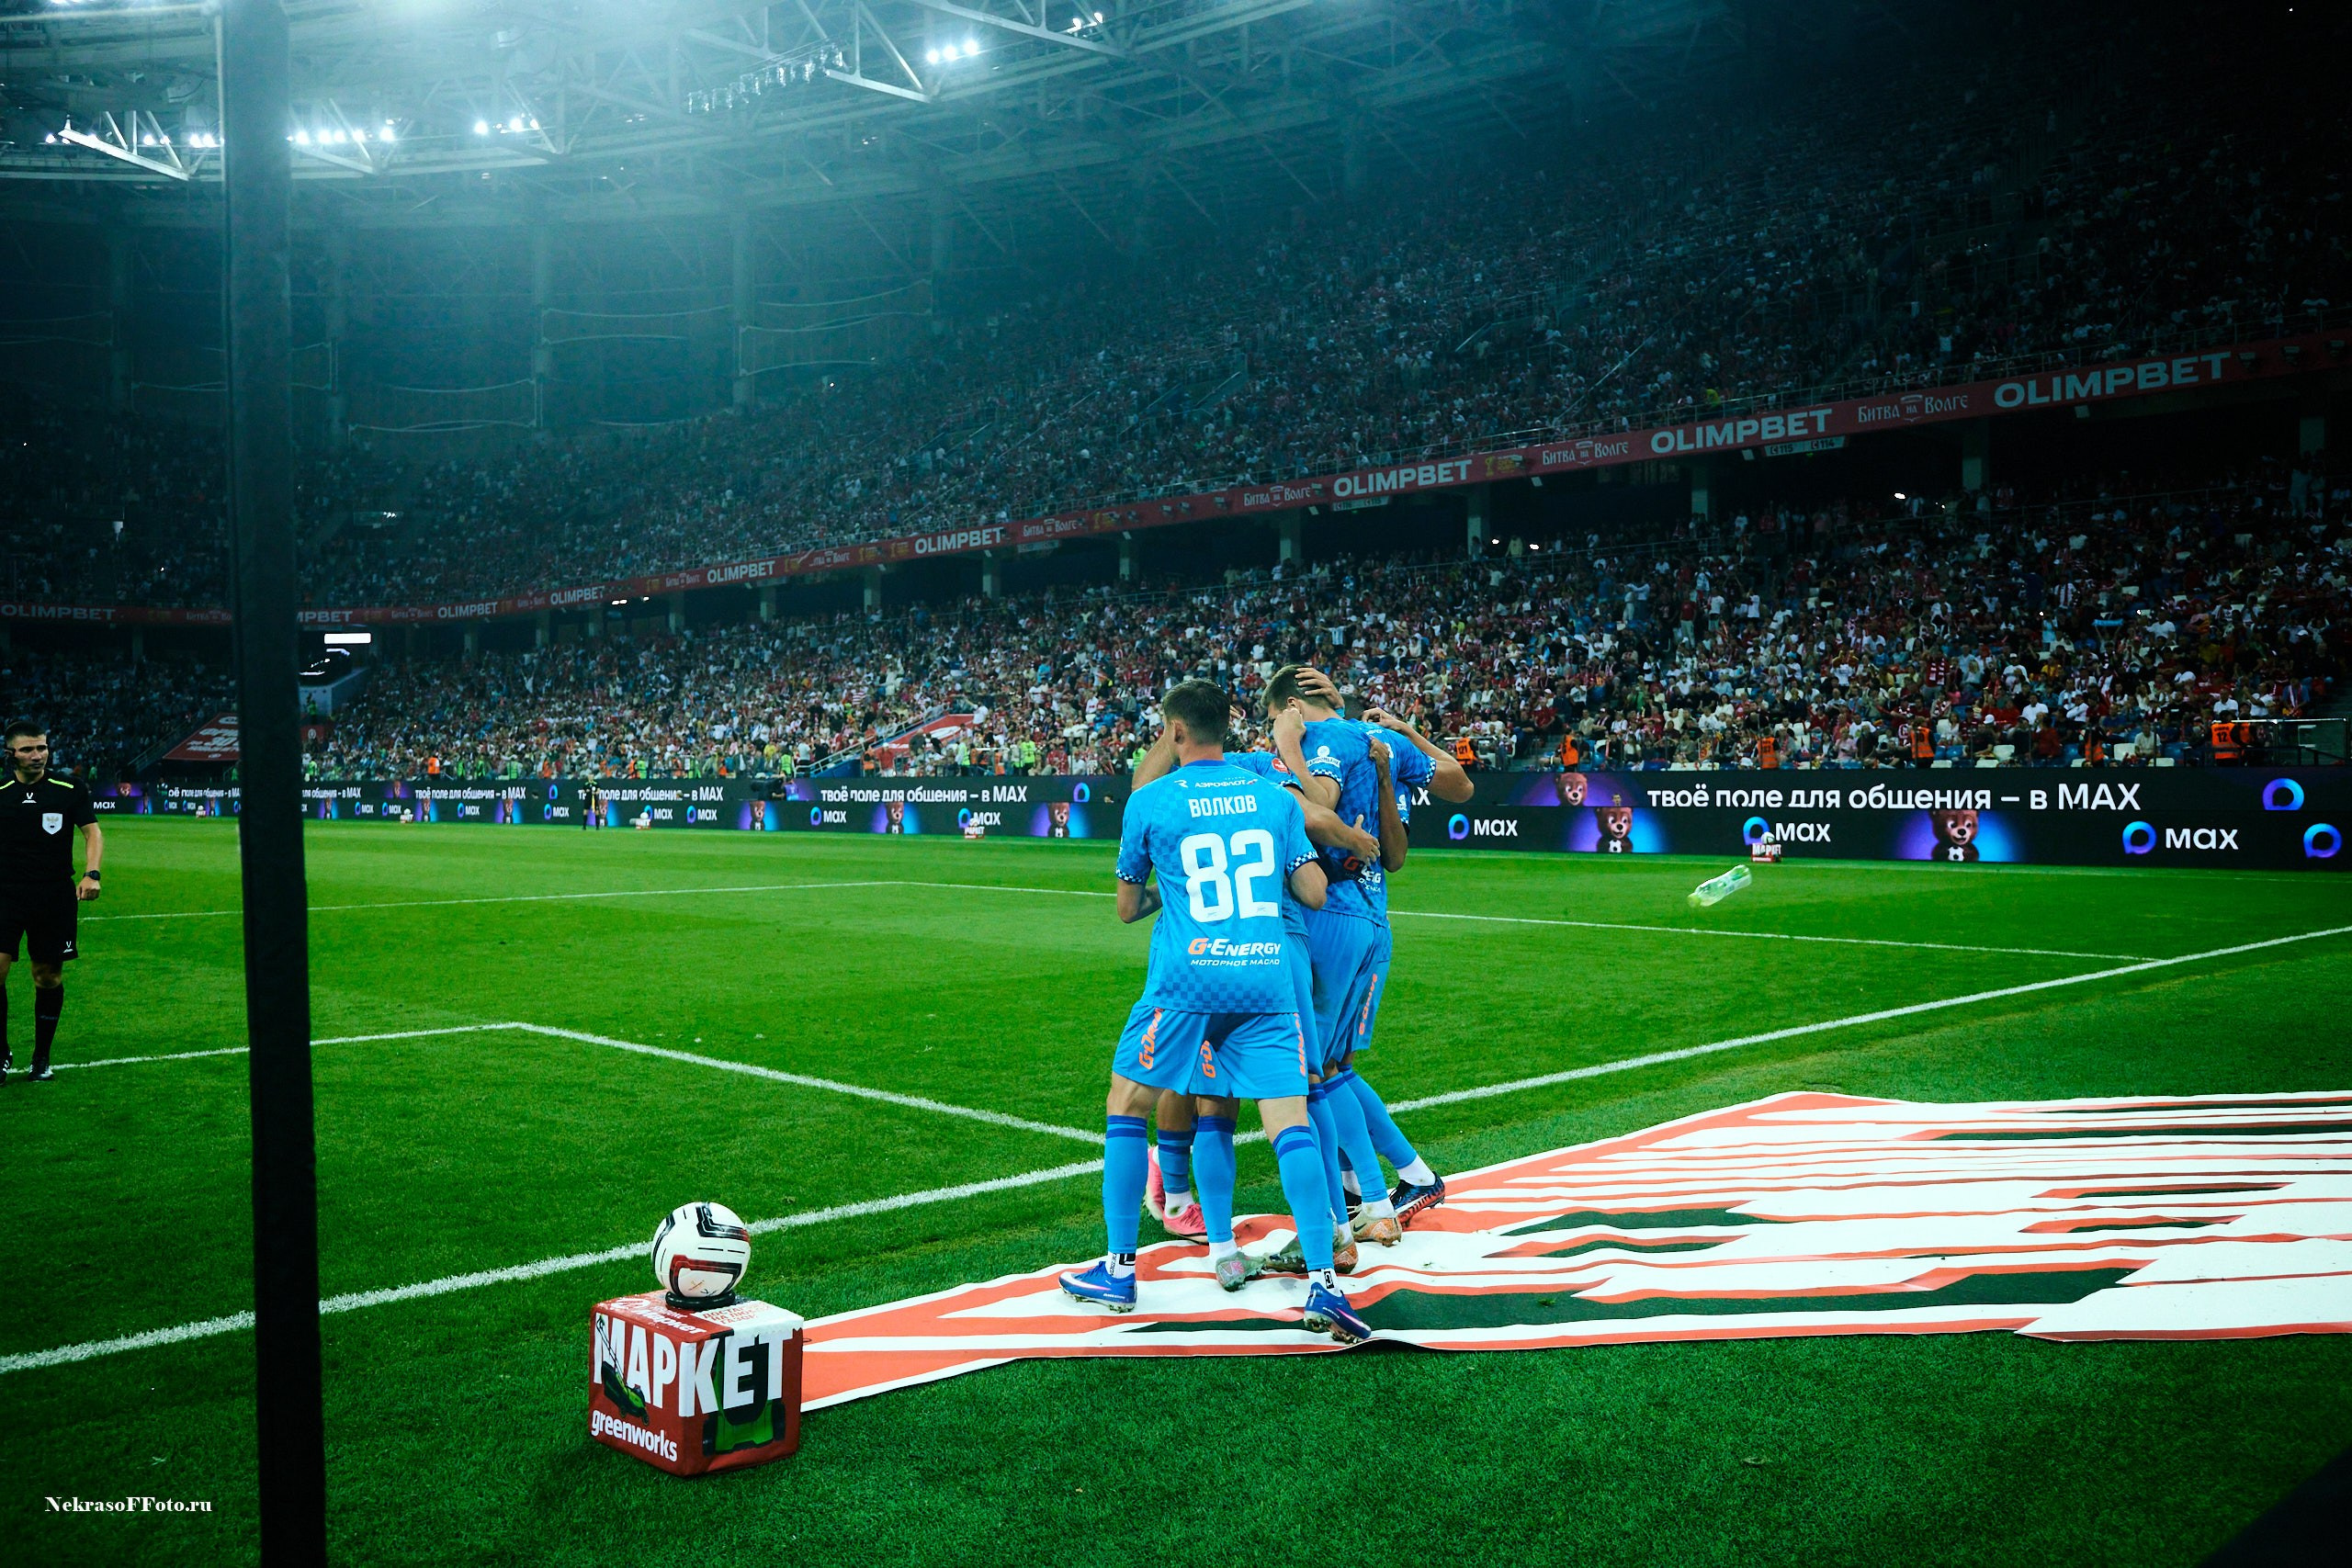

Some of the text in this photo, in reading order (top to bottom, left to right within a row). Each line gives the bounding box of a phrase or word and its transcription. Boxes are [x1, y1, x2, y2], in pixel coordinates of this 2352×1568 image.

[1994, 351, 2231, 408] OLIMPBET
[1651, 409, 1833, 454] OLIMPBET
[1333, 459, 1472, 497] OLIMPBET
[914, 526, 1005, 555] OLIMPBET
[707, 560, 775, 583] OLIMPBET
[551, 585, 605, 605] OLIMPBET
[1, 603, 116, 621] OLIMPBET
[437, 602, 498, 619] OLIMPBET
[993, 786, 1027, 802] MAX
[1188, 795, 1258, 818] ВОЛКОВ
[1647, 784, 1709, 807] твоё
[2058, 784, 2141, 810] MAX
[1180, 829, 1279, 923] 82
[594, 1313, 794, 1417] МАРКЕТ
[591, 1409, 678, 1462] greenworks
